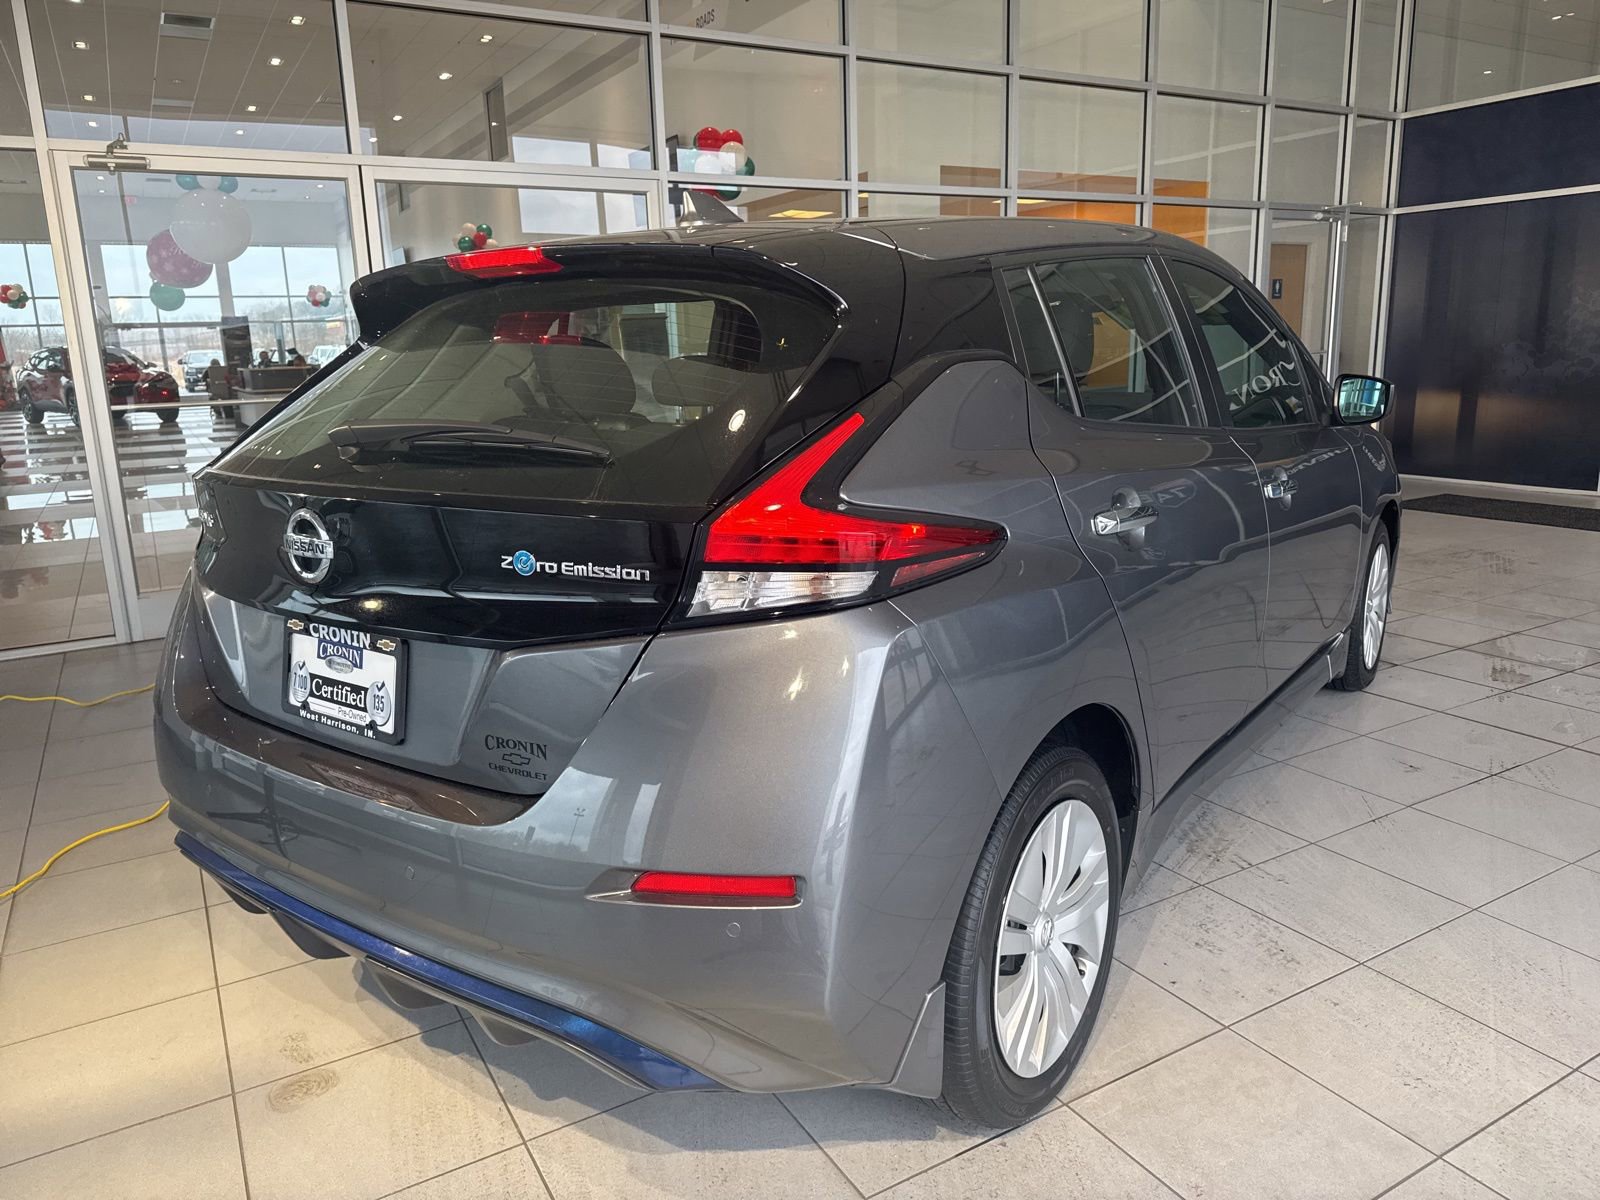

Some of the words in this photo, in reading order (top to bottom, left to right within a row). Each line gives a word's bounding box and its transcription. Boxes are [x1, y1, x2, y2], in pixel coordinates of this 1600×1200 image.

[695, 9, 715, 29] ROADS
[285, 539, 325, 555] NISSAN
[561, 562, 650, 582] Emission
[309, 622, 371, 650] CRONIN
[319, 641, 361, 668] CRONIN
[311, 678, 365, 708] Certified
[372, 693, 385, 713] 135
[300, 709, 319, 722] West
[337, 706, 367, 723] Pre-Owned
[484, 734, 548, 761] CRONIN
[488, 762, 548, 781] CHEVROLET
